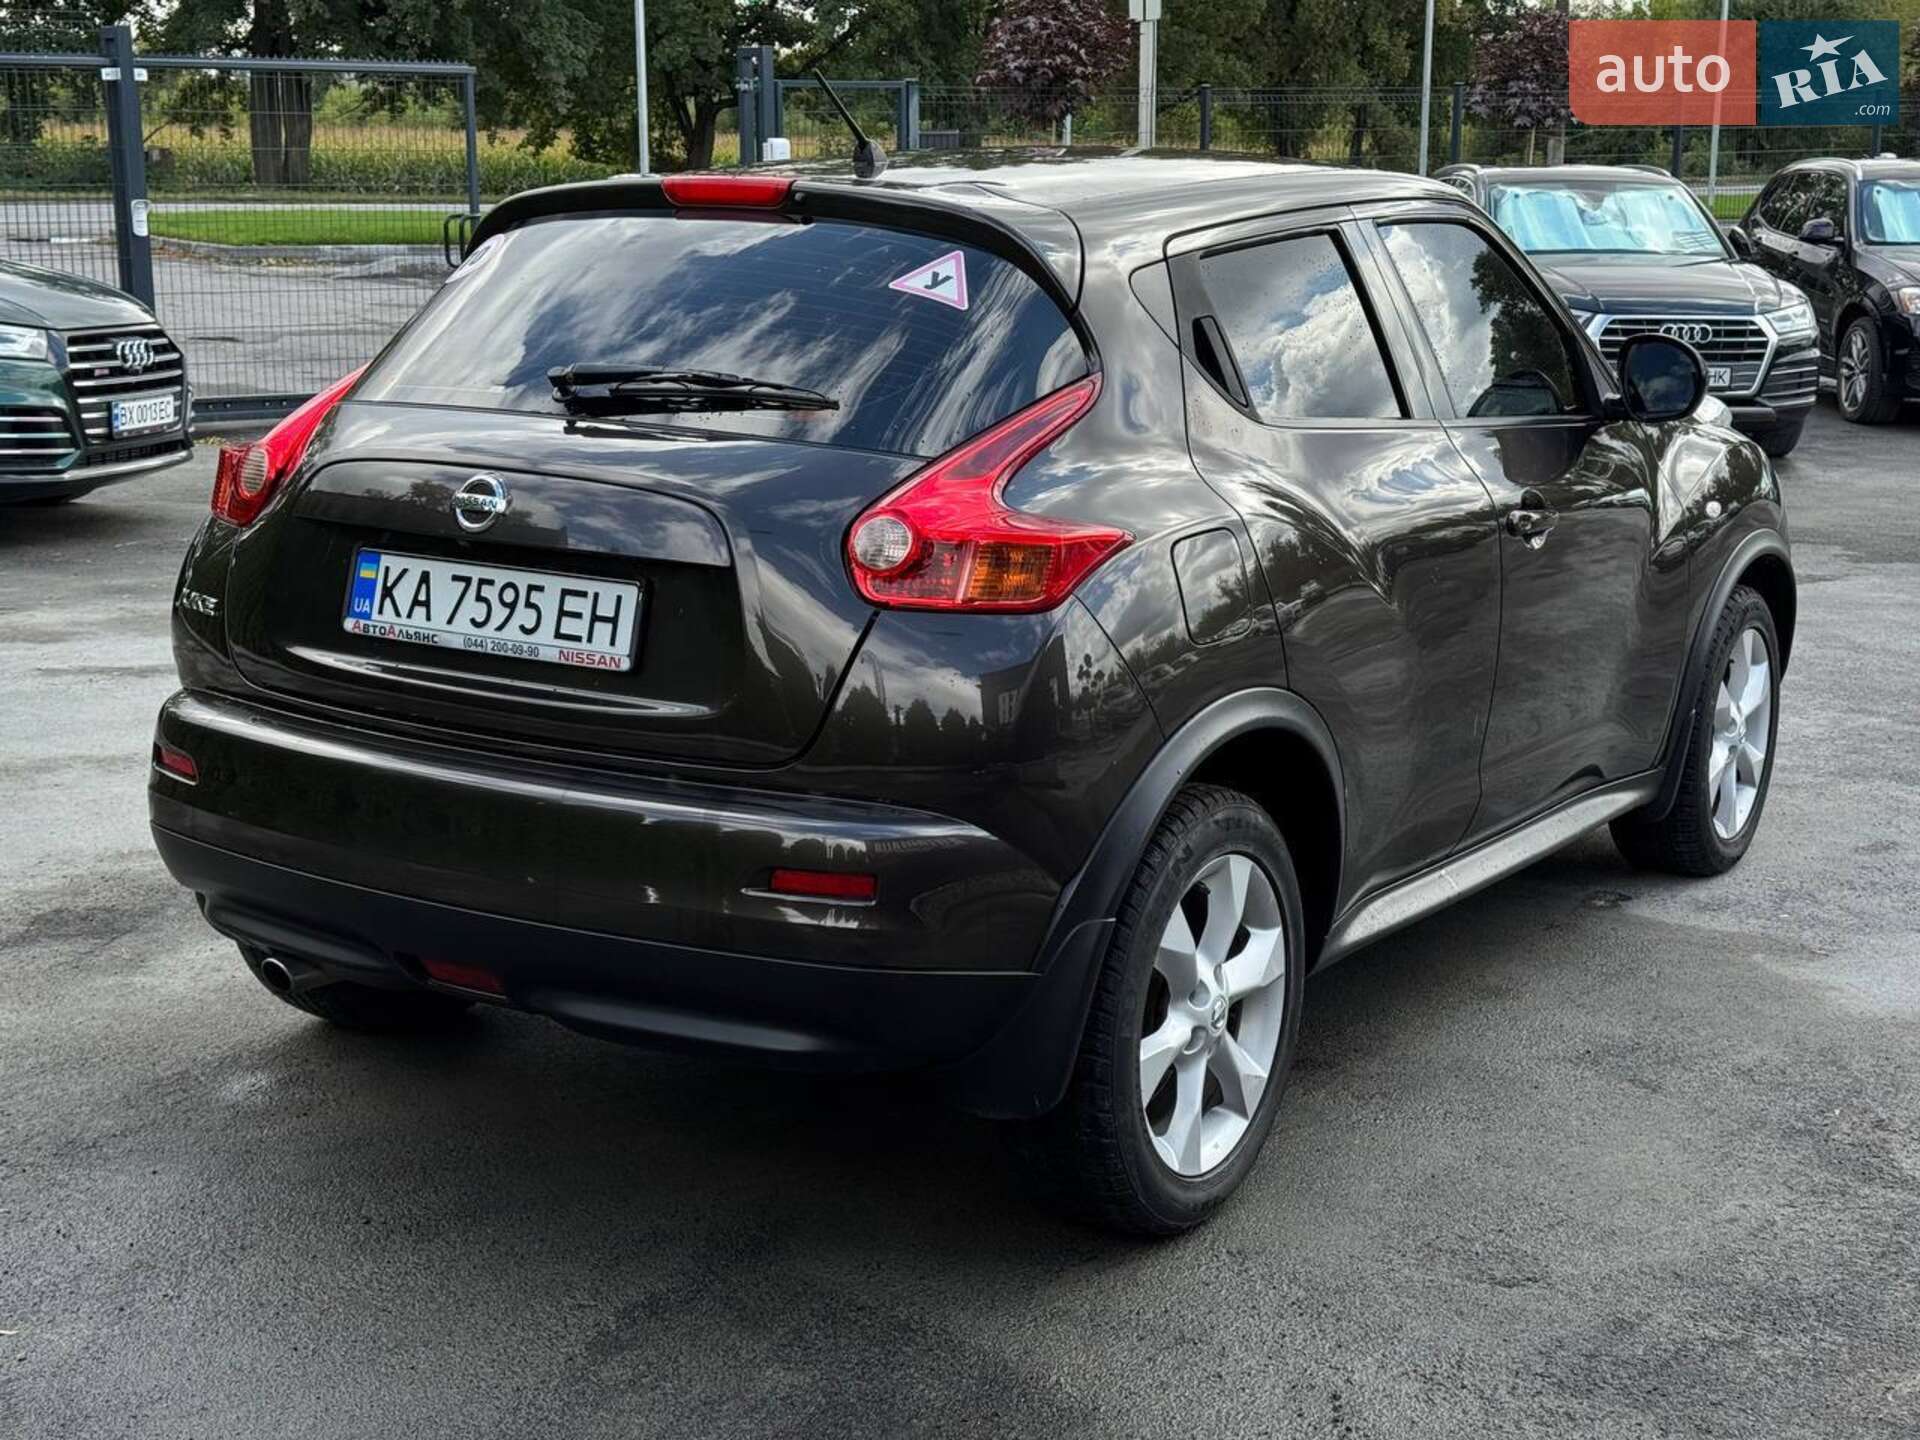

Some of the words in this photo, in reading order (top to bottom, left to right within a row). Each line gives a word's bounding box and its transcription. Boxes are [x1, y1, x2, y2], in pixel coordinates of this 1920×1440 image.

[353, 597, 371, 613] UA
[378, 565, 432, 622] KA
[446, 574, 546, 636] 7595
[553, 587, 623, 647] EH
[463, 636, 488, 651] (044)
[490, 640, 540, 658] 200-09-90
[558, 649, 622, 669] NISSAN
